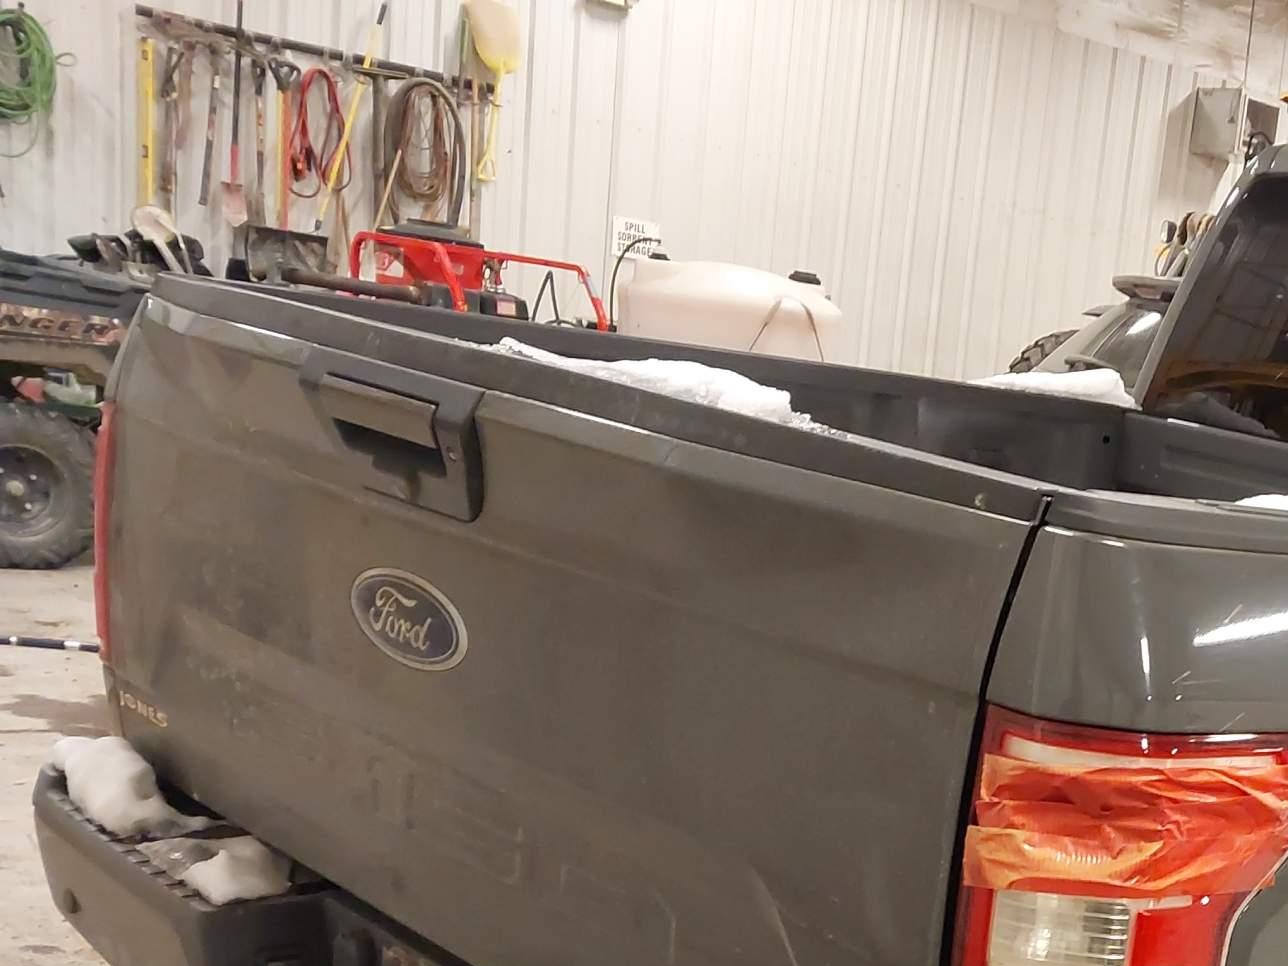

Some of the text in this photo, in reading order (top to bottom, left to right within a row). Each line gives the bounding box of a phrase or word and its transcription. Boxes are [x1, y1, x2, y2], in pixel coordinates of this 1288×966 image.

[624, 221, 646, 234] SPILL
[617, 242, 652, 257] STRAGE
[369, 586, 431, 650] Ford
